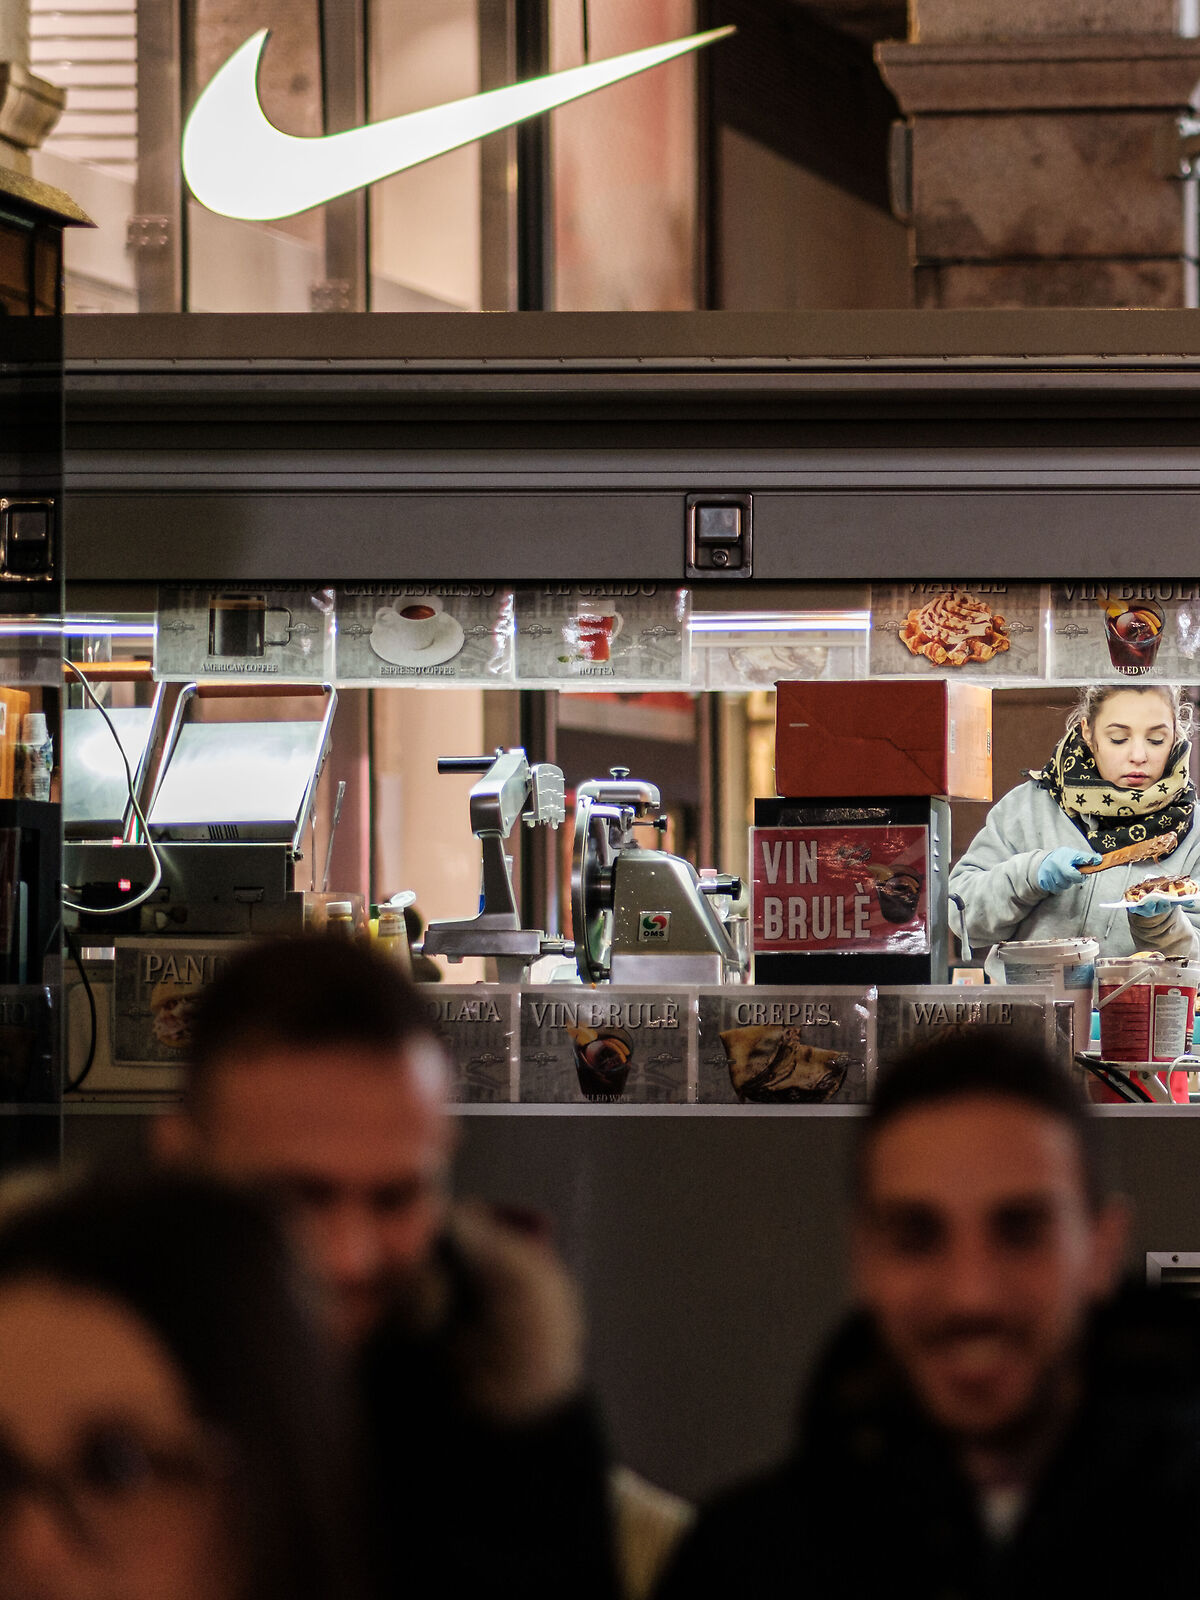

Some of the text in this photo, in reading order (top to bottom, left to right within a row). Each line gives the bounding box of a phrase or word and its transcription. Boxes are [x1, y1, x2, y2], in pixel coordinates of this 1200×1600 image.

[1063, 583, 1110, 601] VIN
[201, 663, 279, 673] AMERICAN COFFEE
[380, 666, 456, 676] ESPRESSO COFFEE
[579, 666, 615, 676] HOT TEA
[762, 840, 818, 884] VIN
[764, 882, 871, 940] BRULÈ
[529, 997, 681, 1029] VIN BRULÈ
[734, 1002, 832, 1027] CREPES
